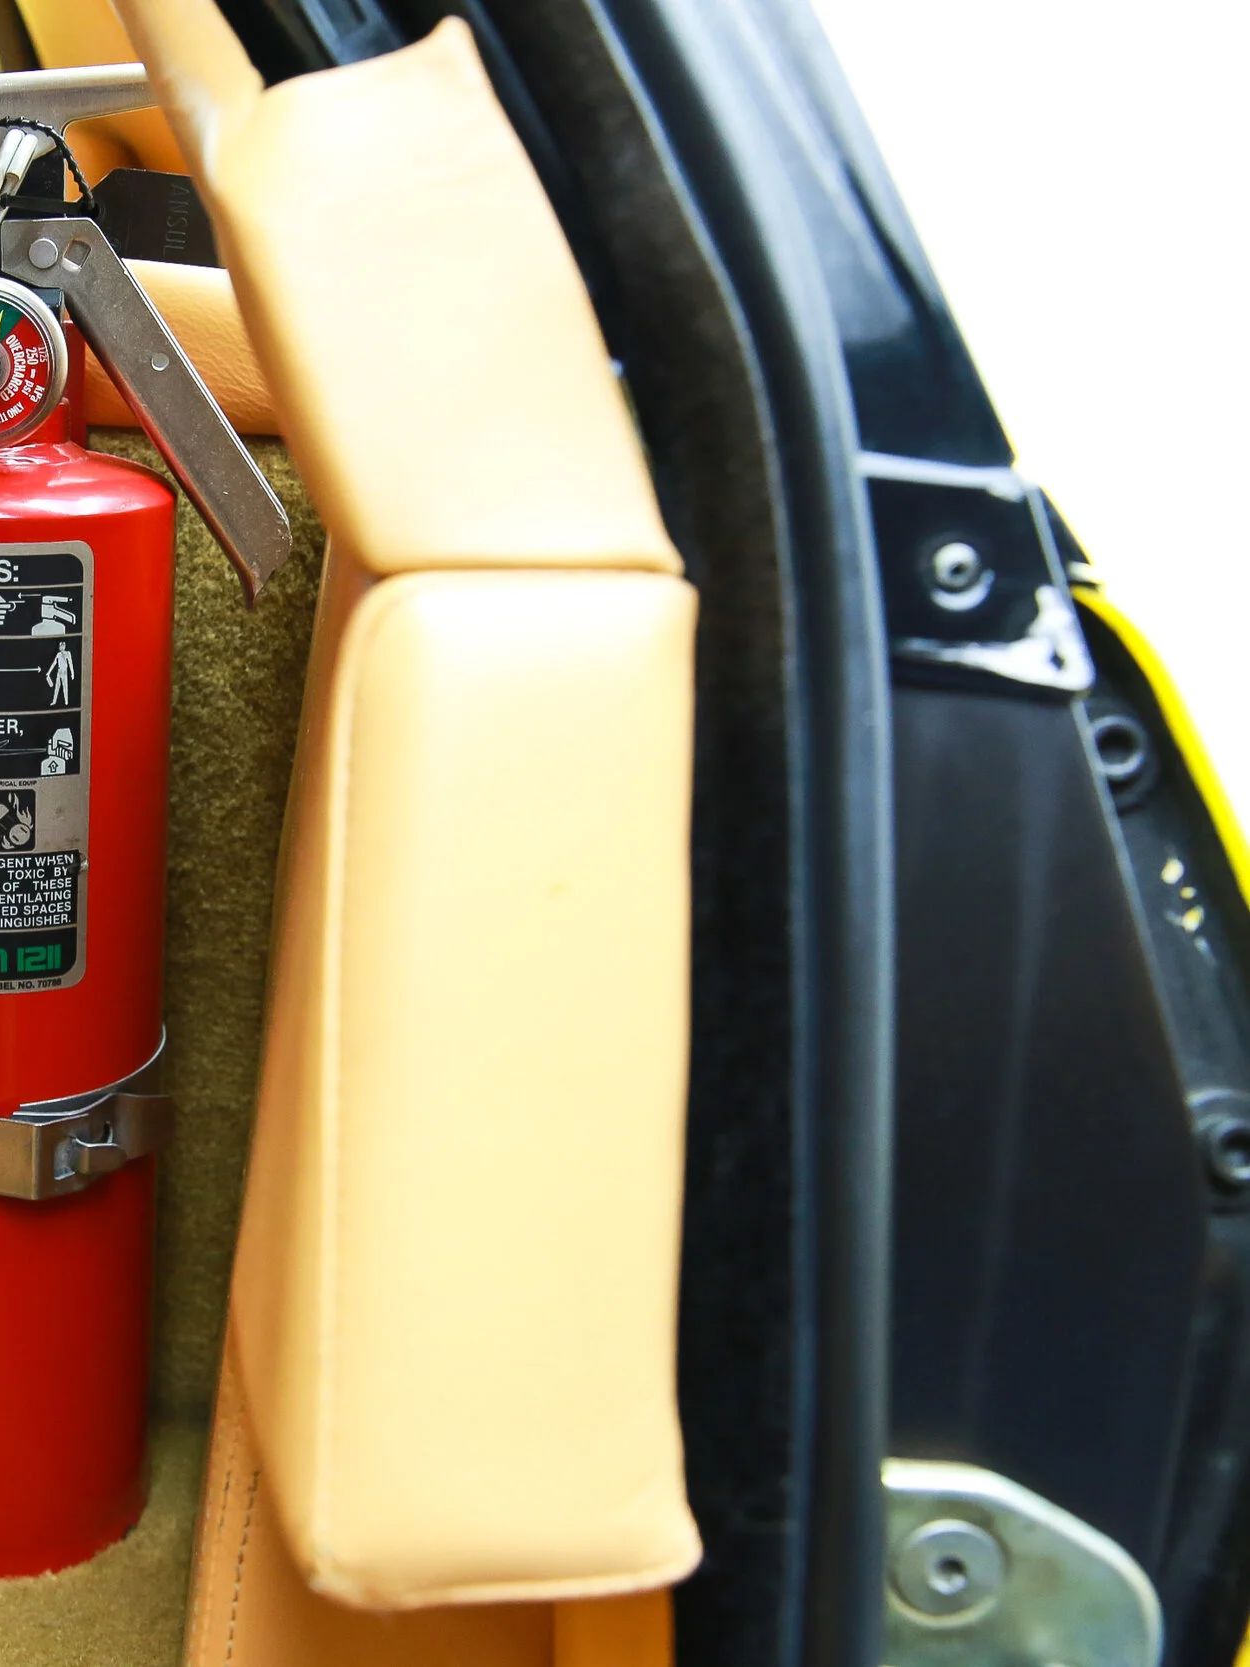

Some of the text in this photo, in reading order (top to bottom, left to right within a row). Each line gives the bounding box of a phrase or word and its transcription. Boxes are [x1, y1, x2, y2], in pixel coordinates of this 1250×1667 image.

[158, 183, 190, 258] ANSUL
[26, 347, 38, 365] 250
[0, 334, 26, 402] OVERCHARGED
[6, 402, 25, 419] ONLY
[35, 854, 74, 866] WHEN
[8, 869, 45, 880] TOXIC
[54, 866, 69, 877] BY
[2, 881, 20, 892] OF
[33, 878, 72, 890] THESE
[23, 902, 71, 915] SPACES
[17, 944, 61, 972] 1211
[18, 981, 35, 989] NO.
